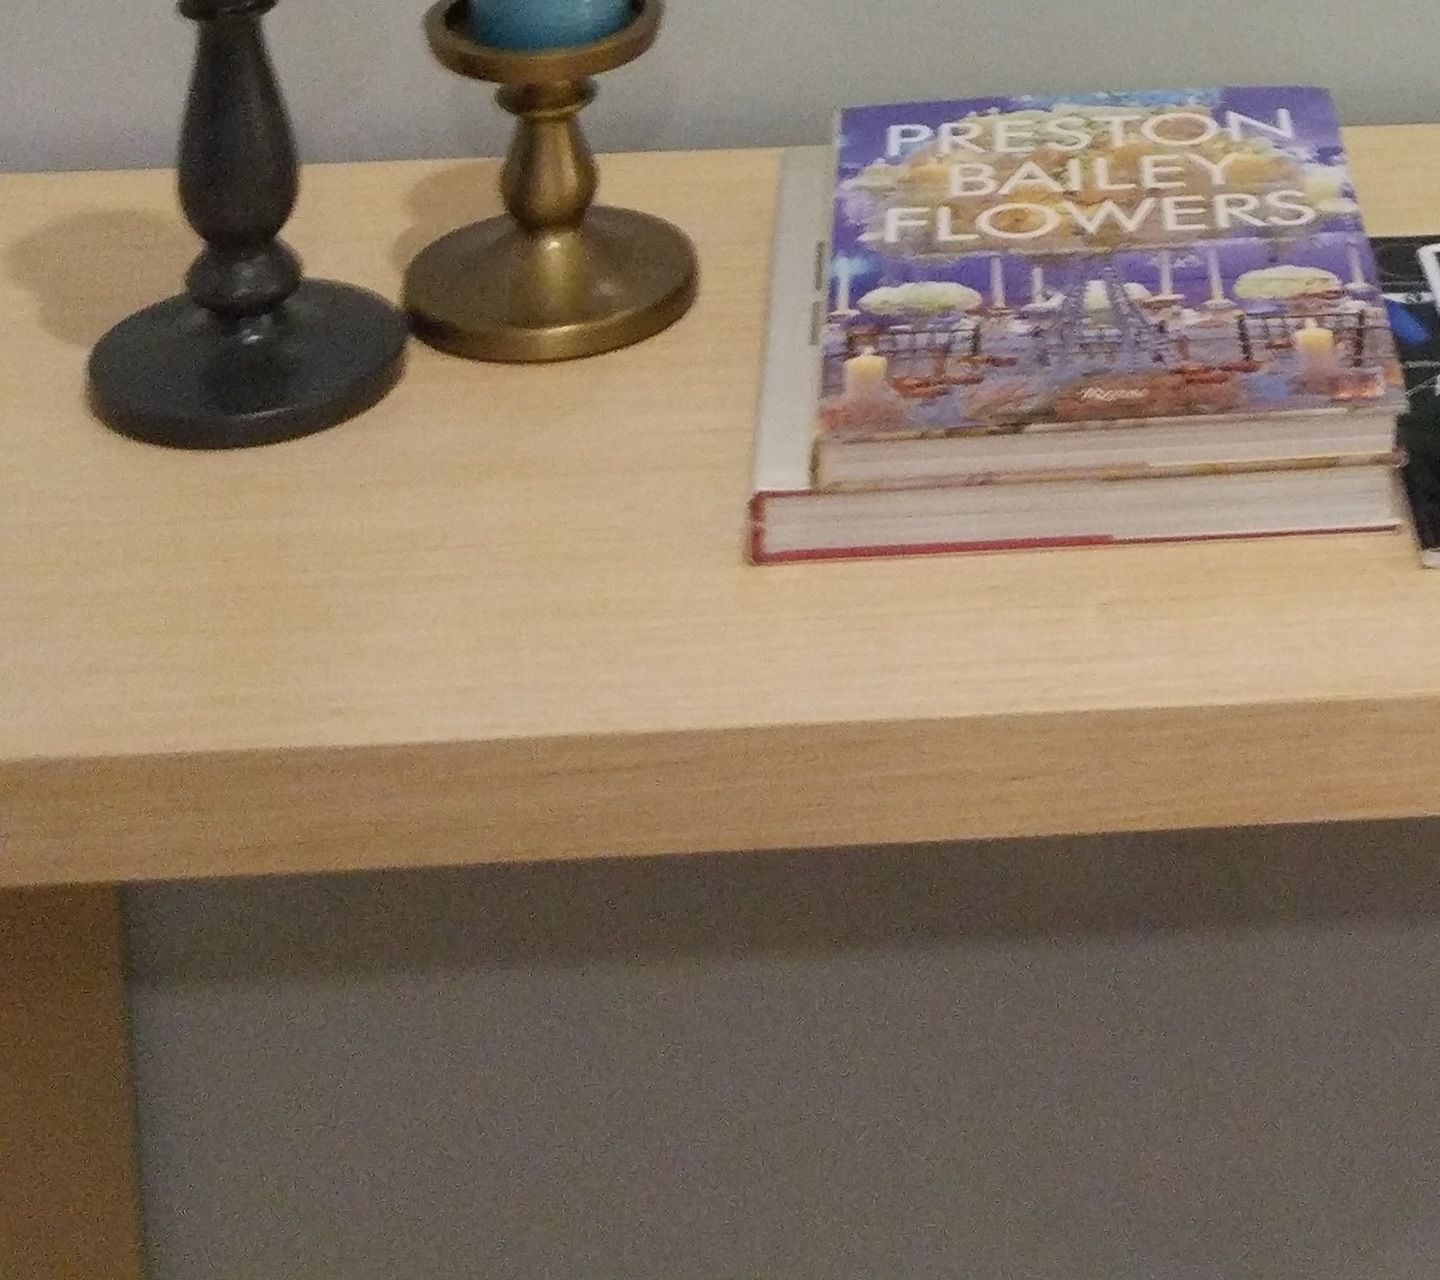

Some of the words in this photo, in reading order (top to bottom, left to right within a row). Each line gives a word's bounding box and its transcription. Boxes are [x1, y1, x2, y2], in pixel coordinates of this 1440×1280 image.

[886, 108, 1296, 157] PRESTON
[949, 153, 1239, 198] BAILEY
[884, 188, 1316, 242] FLOWERS
